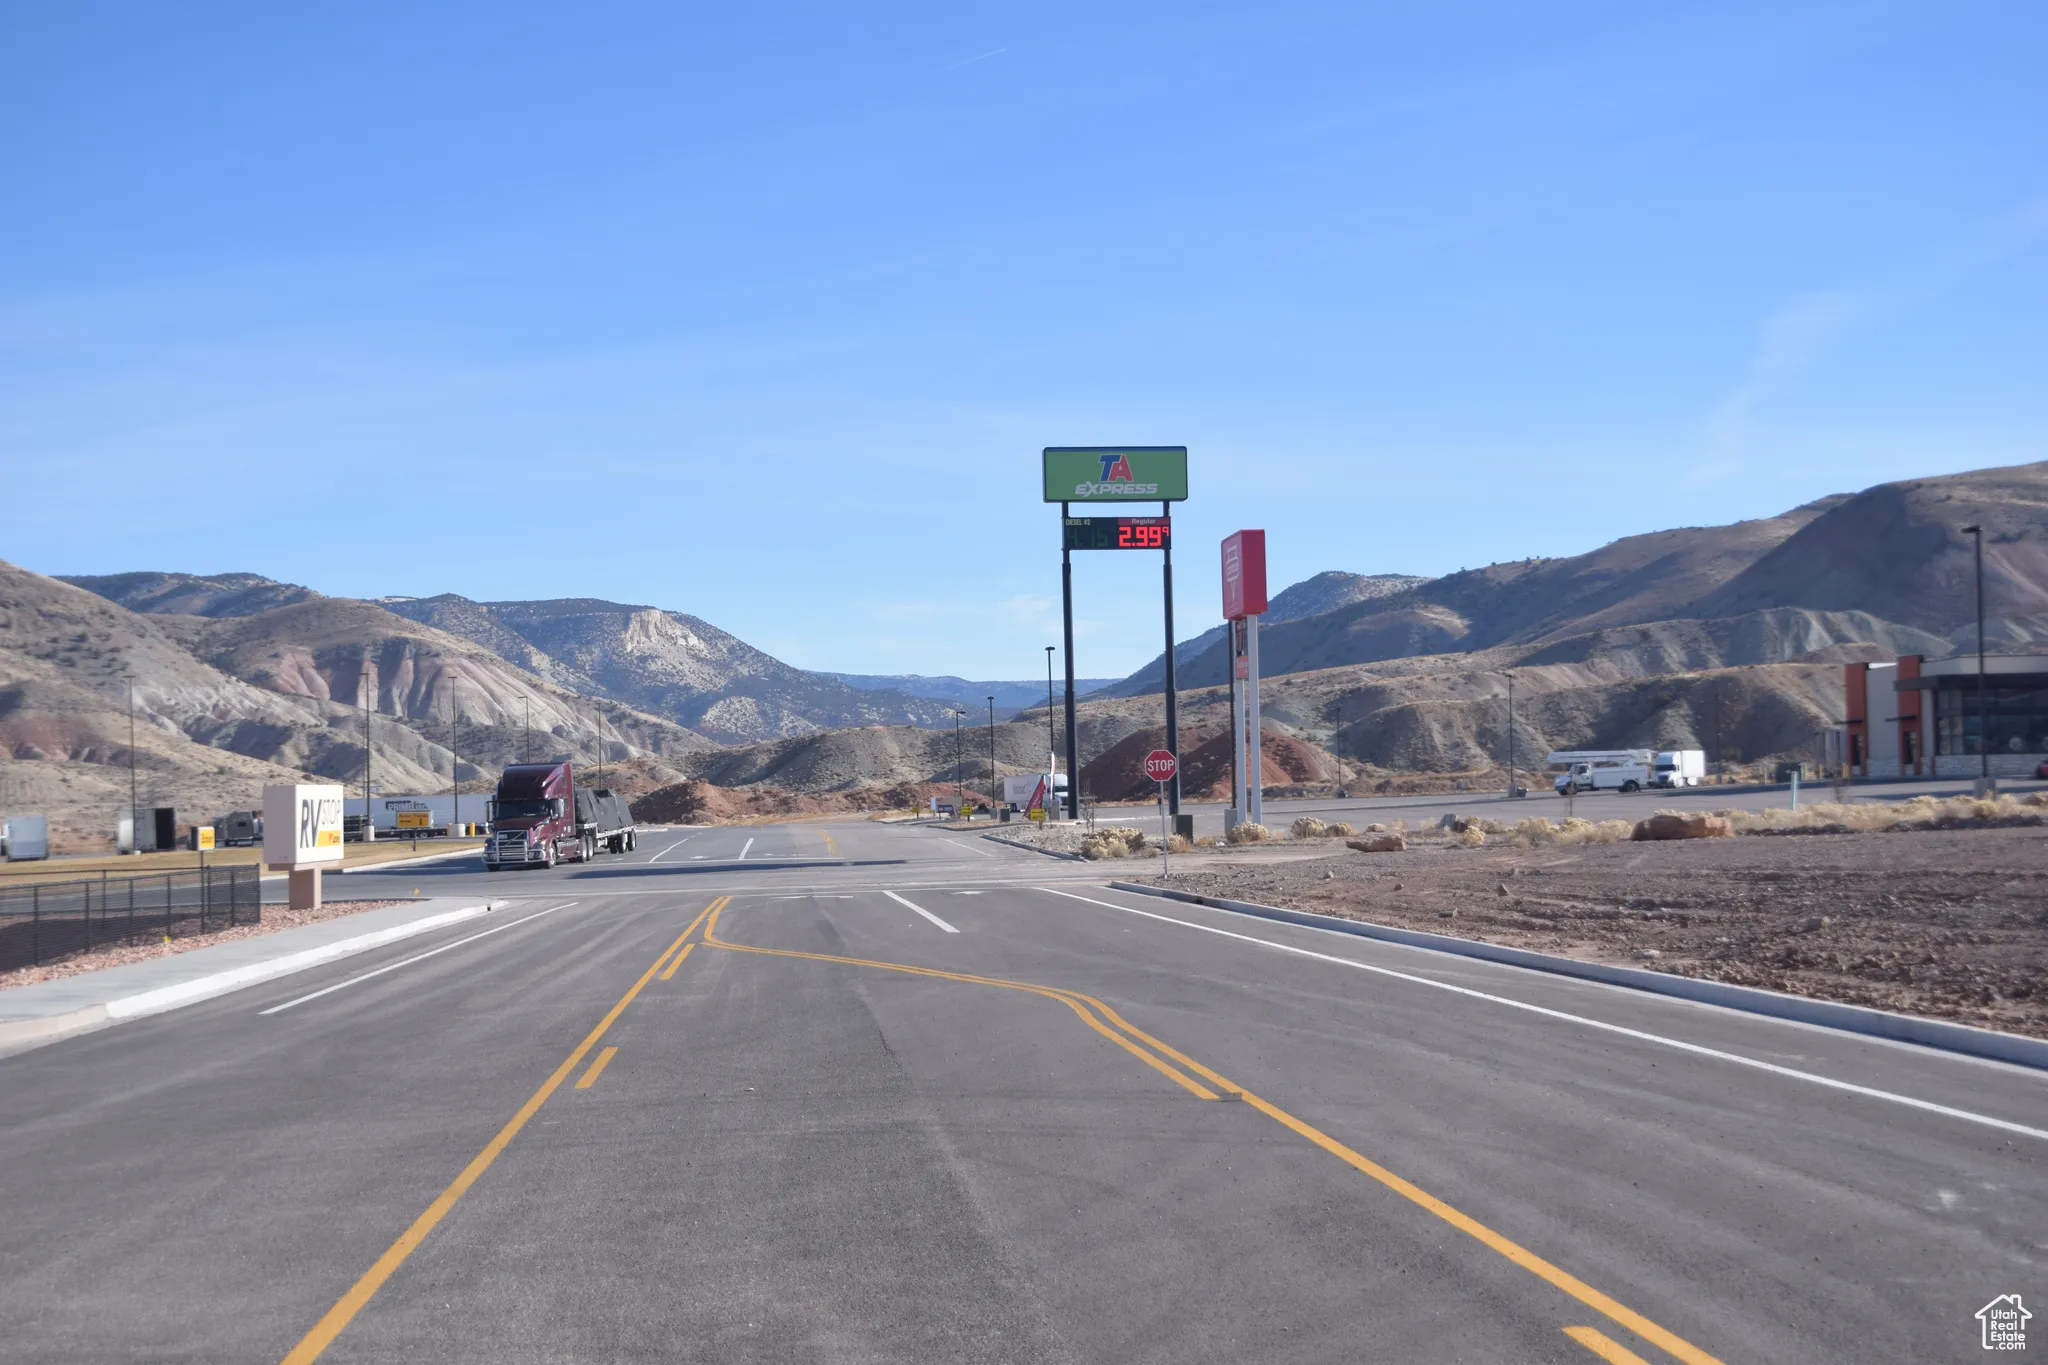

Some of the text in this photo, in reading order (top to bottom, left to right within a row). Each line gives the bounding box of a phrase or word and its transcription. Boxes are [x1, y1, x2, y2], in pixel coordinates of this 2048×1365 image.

[1098, 454, 1134, 482] TA
[1074, 481, 1158, 497] EXPRESS
[1147, 759, 1174, 772] STOP
[386, 800, 413, 811] PRIME
[300, 799, 342, 849] RV STOP
